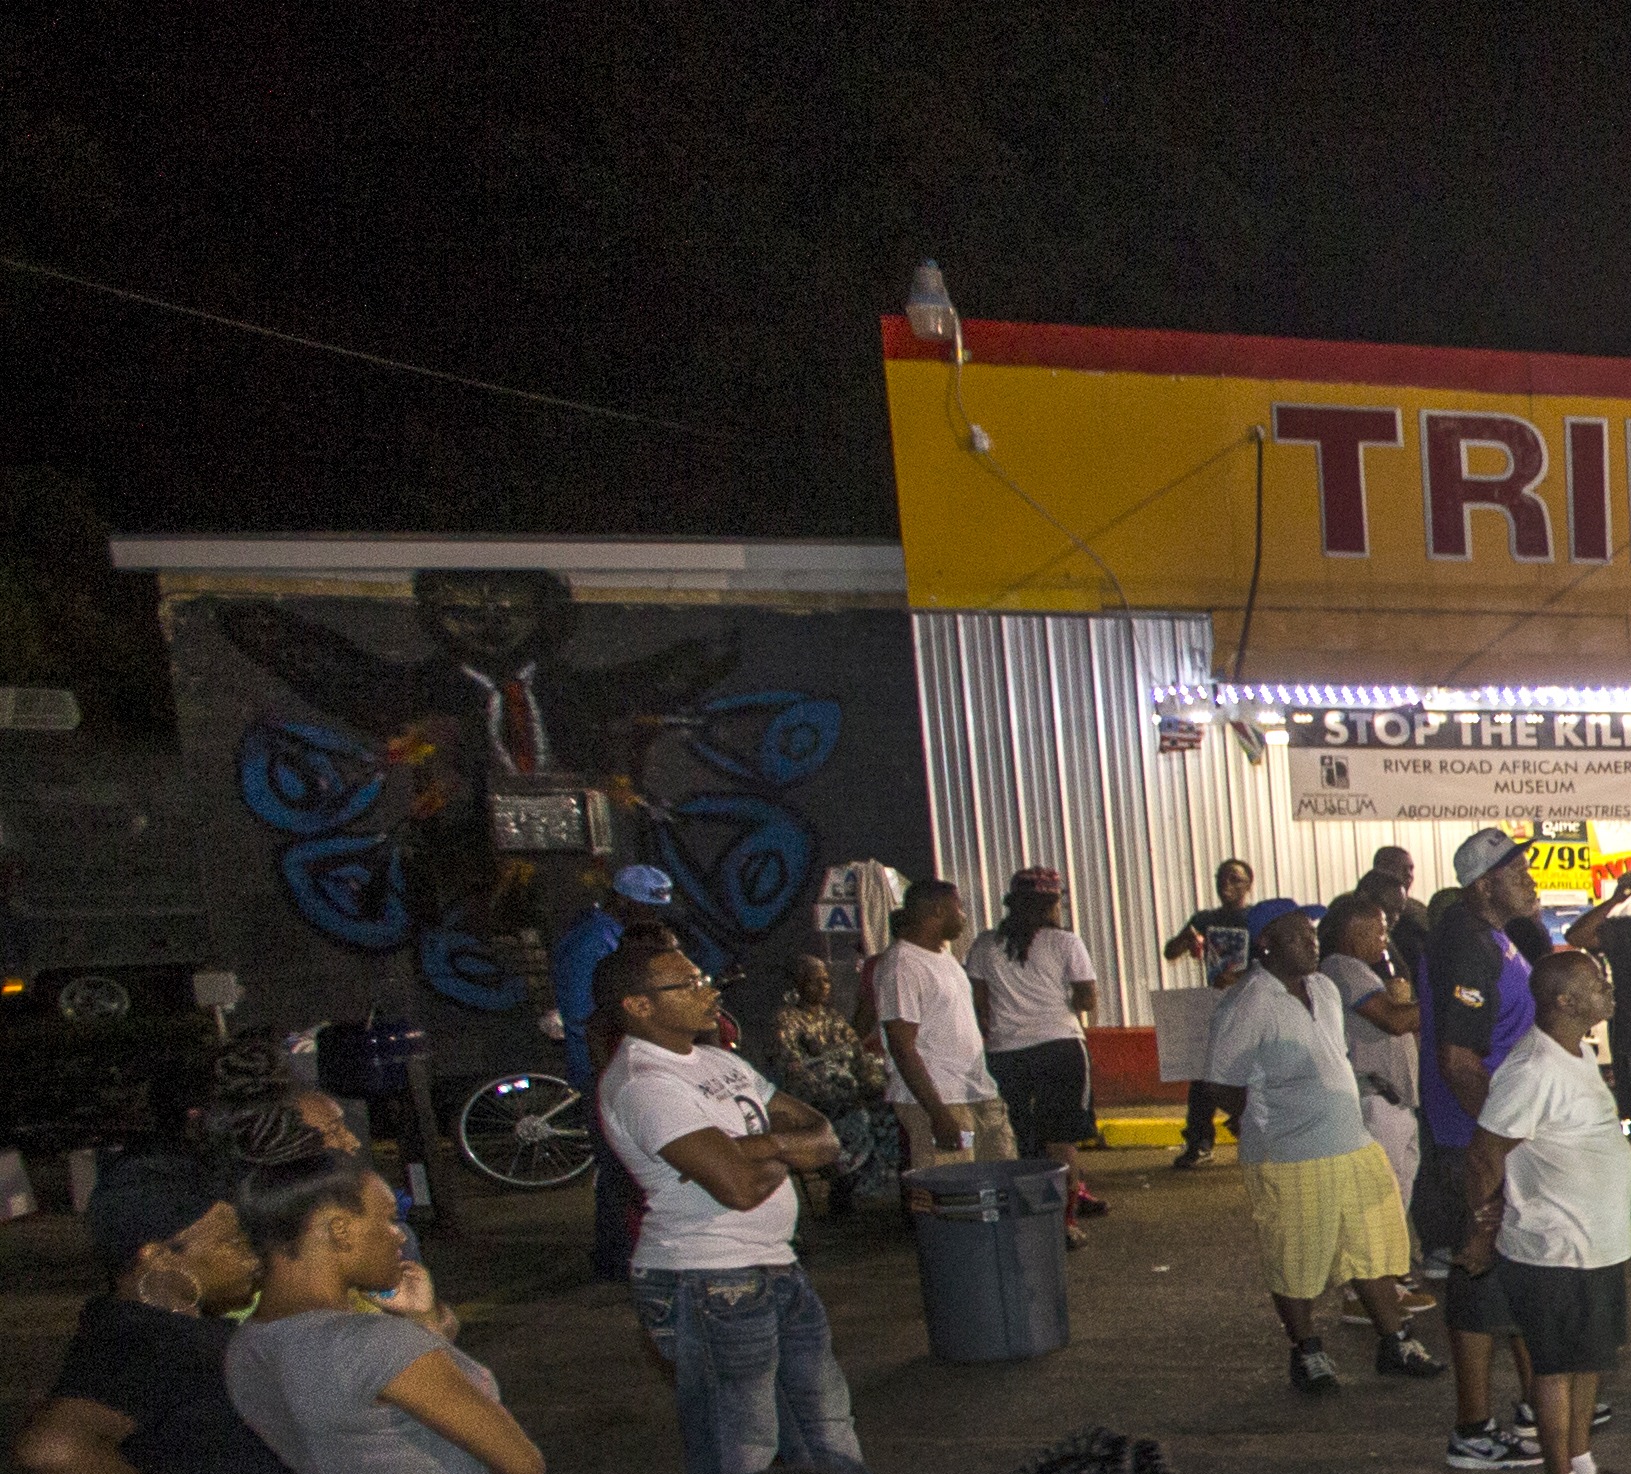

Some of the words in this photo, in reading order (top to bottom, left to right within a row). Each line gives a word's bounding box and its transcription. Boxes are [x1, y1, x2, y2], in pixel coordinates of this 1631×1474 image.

[1324, 709, 1442, 746] STOP
[1453, 711, 1538, 747] THE
[1383, 758, 1433, 775] RIVER
[1439, 759, 1493, 775] ROAD
[1499, 760, 1579, 775] AFRICAN
[1493, 780, 1576, 795] MUSEUM
[1397, 804, 1500, 818] ABOUNDING
[1504, 804, 1542, 818] LOVE
[1547, 804, 1631, 818] MINISTRIES
[1541, 820, 1581, 840] game
